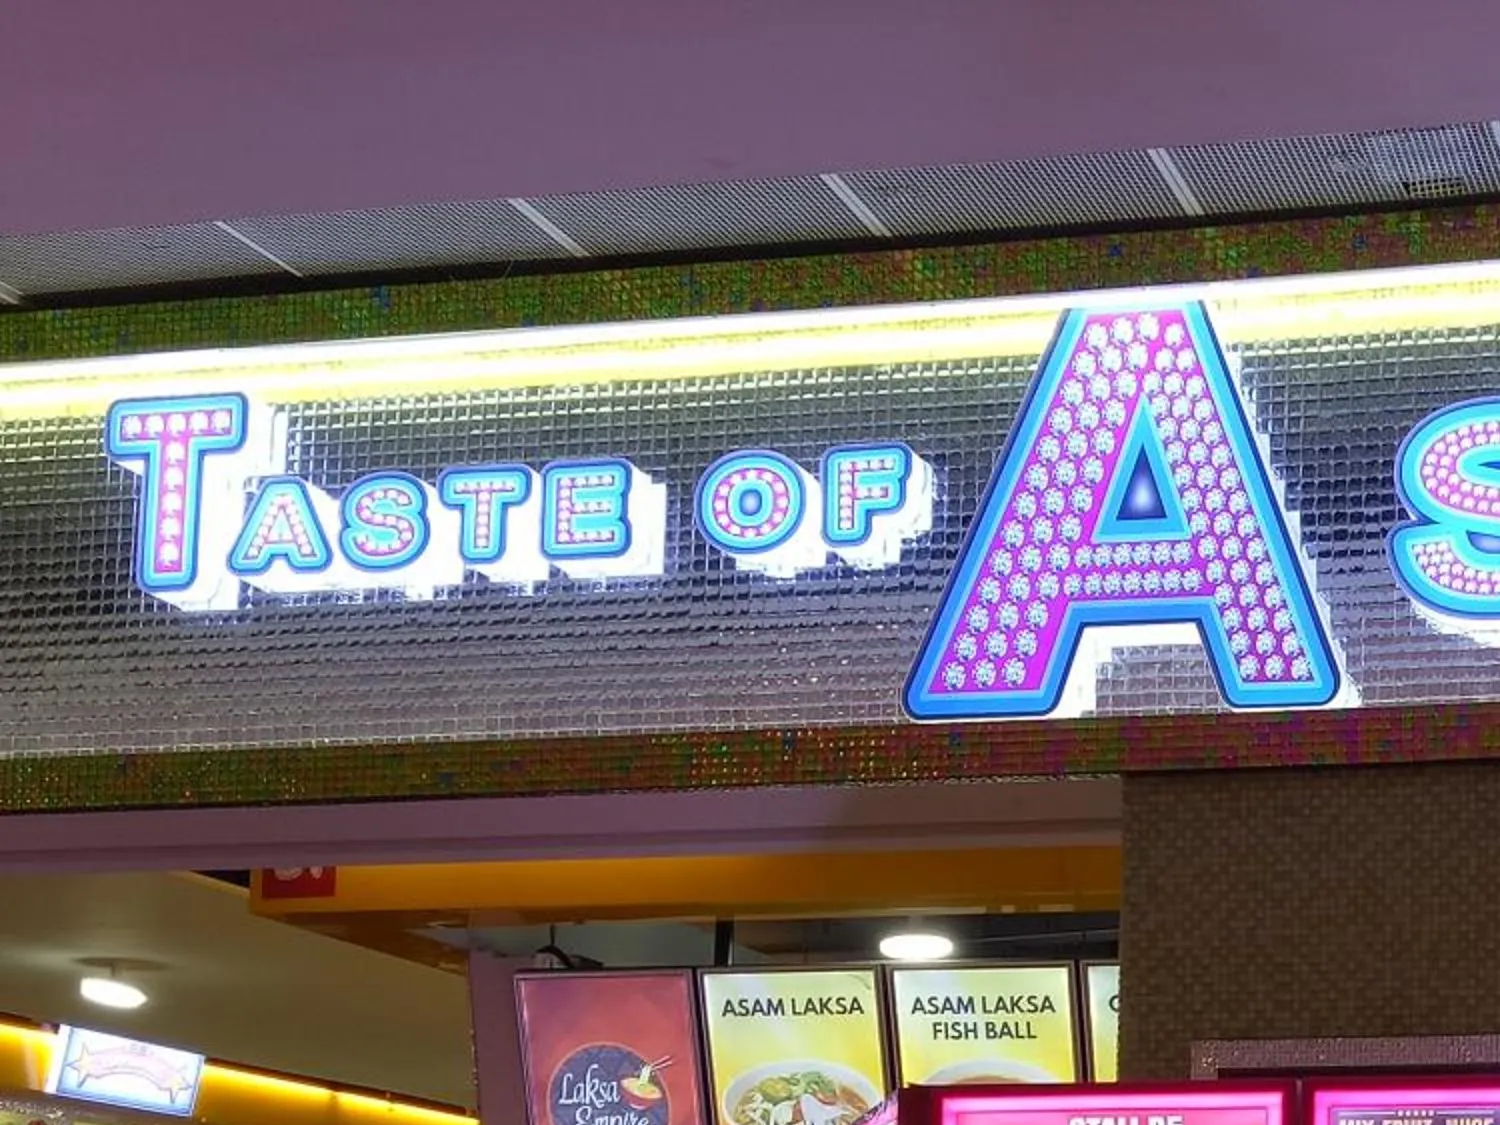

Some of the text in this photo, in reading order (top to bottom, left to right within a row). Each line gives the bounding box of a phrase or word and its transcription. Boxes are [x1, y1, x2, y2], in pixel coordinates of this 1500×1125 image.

[104, 391, 634, 592] TASTE
[694, 440, 913, 556] OF
[721, 996, 865, 1017] ASAM LAKSA
[911, 994, 1056, 1015] ASAM LAKSA
[932, 1020, 1038, 1041] FISH BALL
[558, 1063, 621, 1109] Laksa
